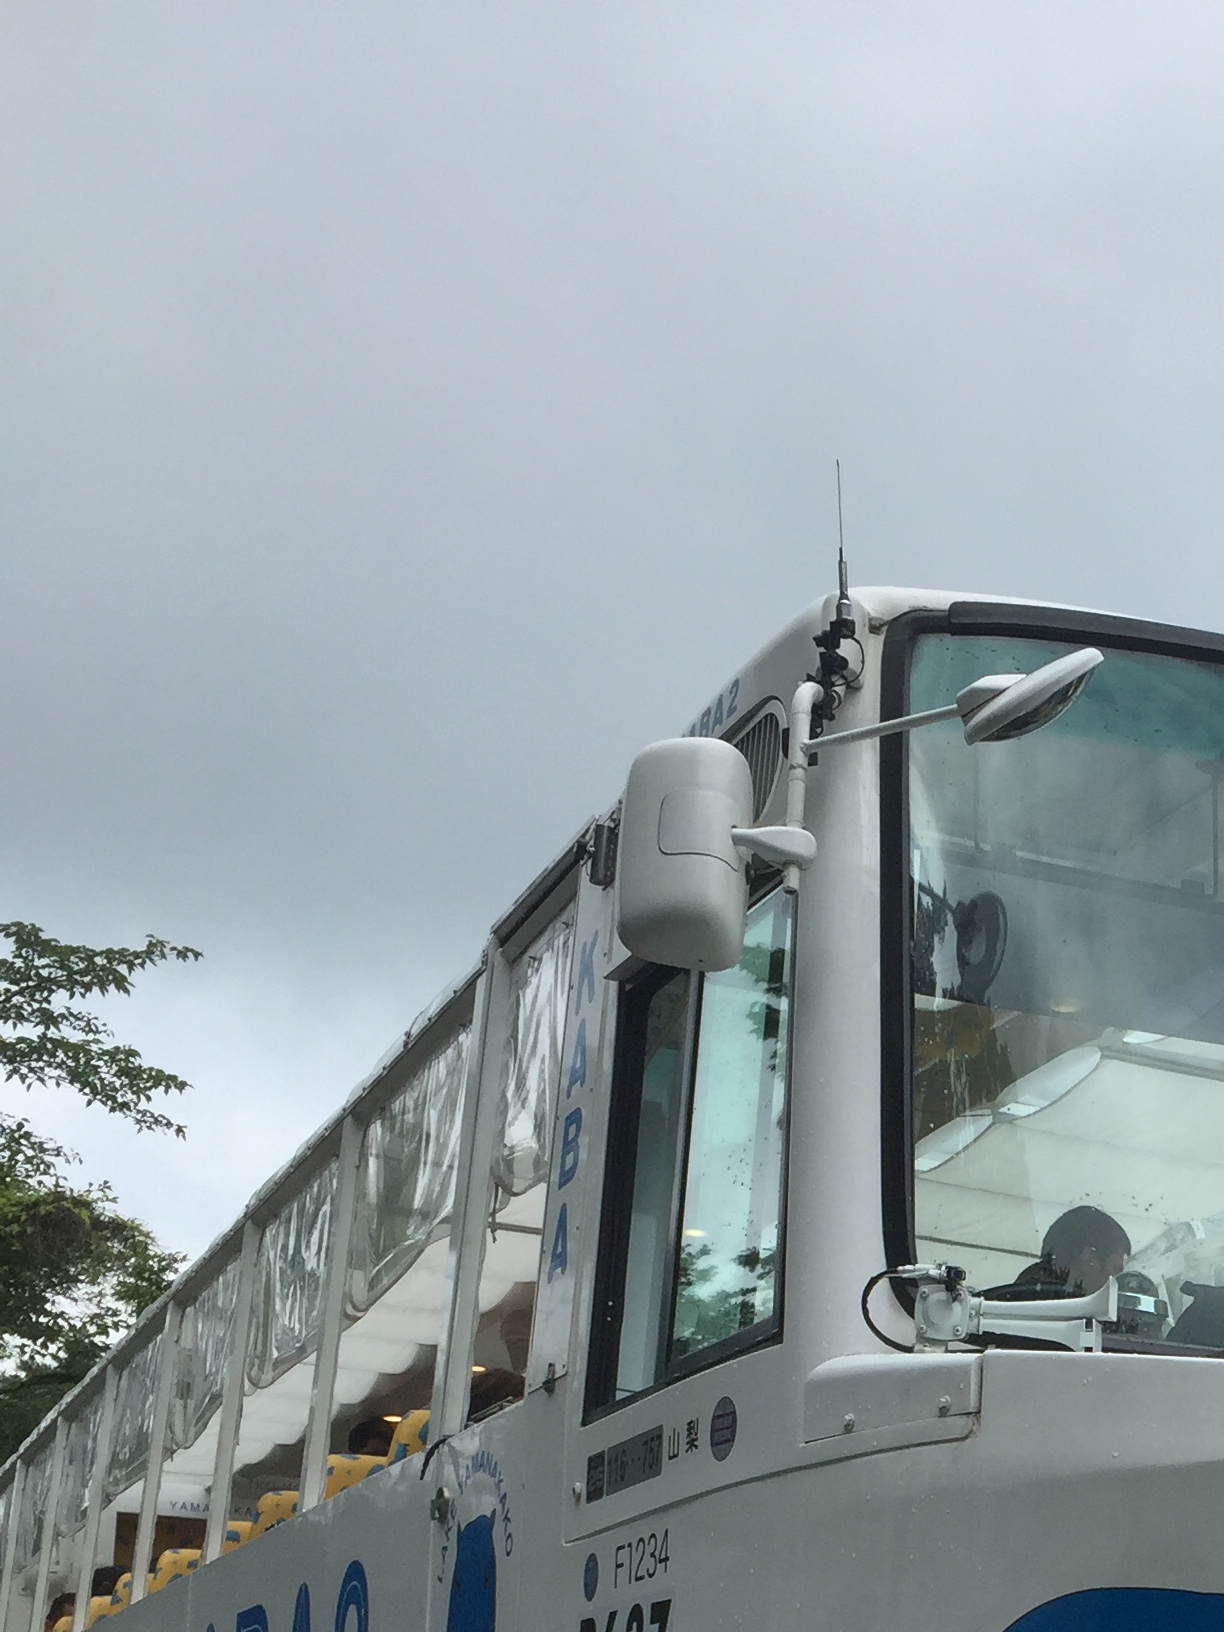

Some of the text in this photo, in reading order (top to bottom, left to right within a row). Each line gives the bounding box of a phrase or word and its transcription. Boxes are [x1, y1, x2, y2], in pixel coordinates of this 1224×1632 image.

[547, 930, 599, 1285] KABA
[668, 1417, 699, 1461] 山梨
[614, 1528, 670, 1588] F1234
